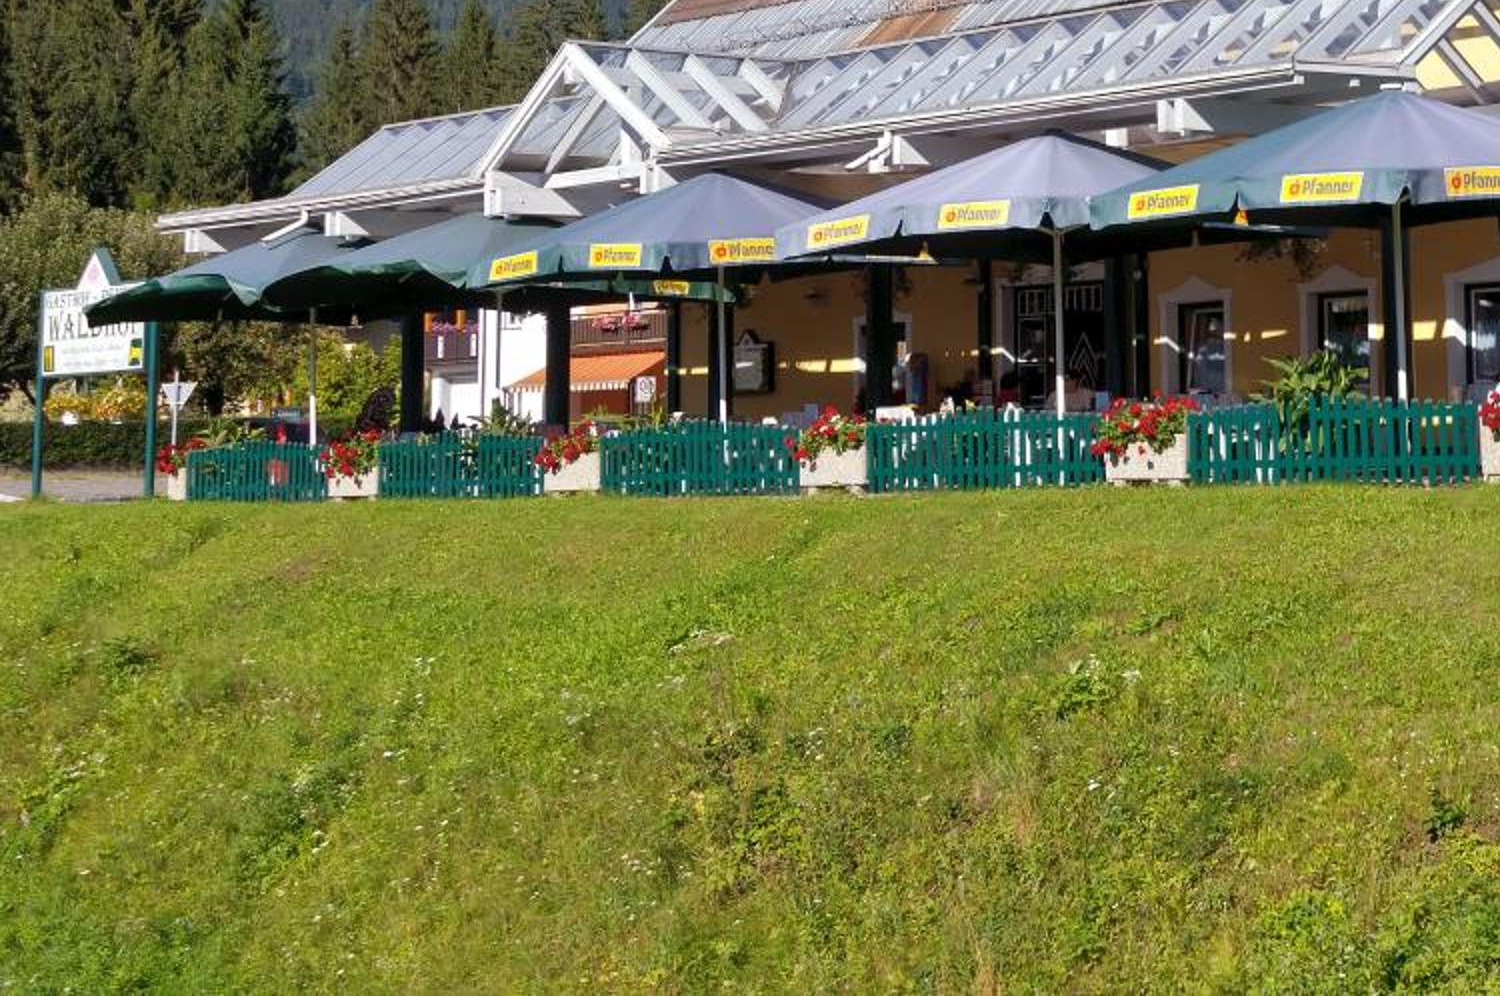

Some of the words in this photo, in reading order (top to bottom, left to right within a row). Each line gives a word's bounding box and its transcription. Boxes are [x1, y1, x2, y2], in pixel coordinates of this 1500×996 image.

[1302, 179, 1355, 195] Pfanner
[1147, 191, 1191, 210] Pfanner
[957, 207, 1001, 221] Pfanner
[729, 243, 774, 258] Pfanne
